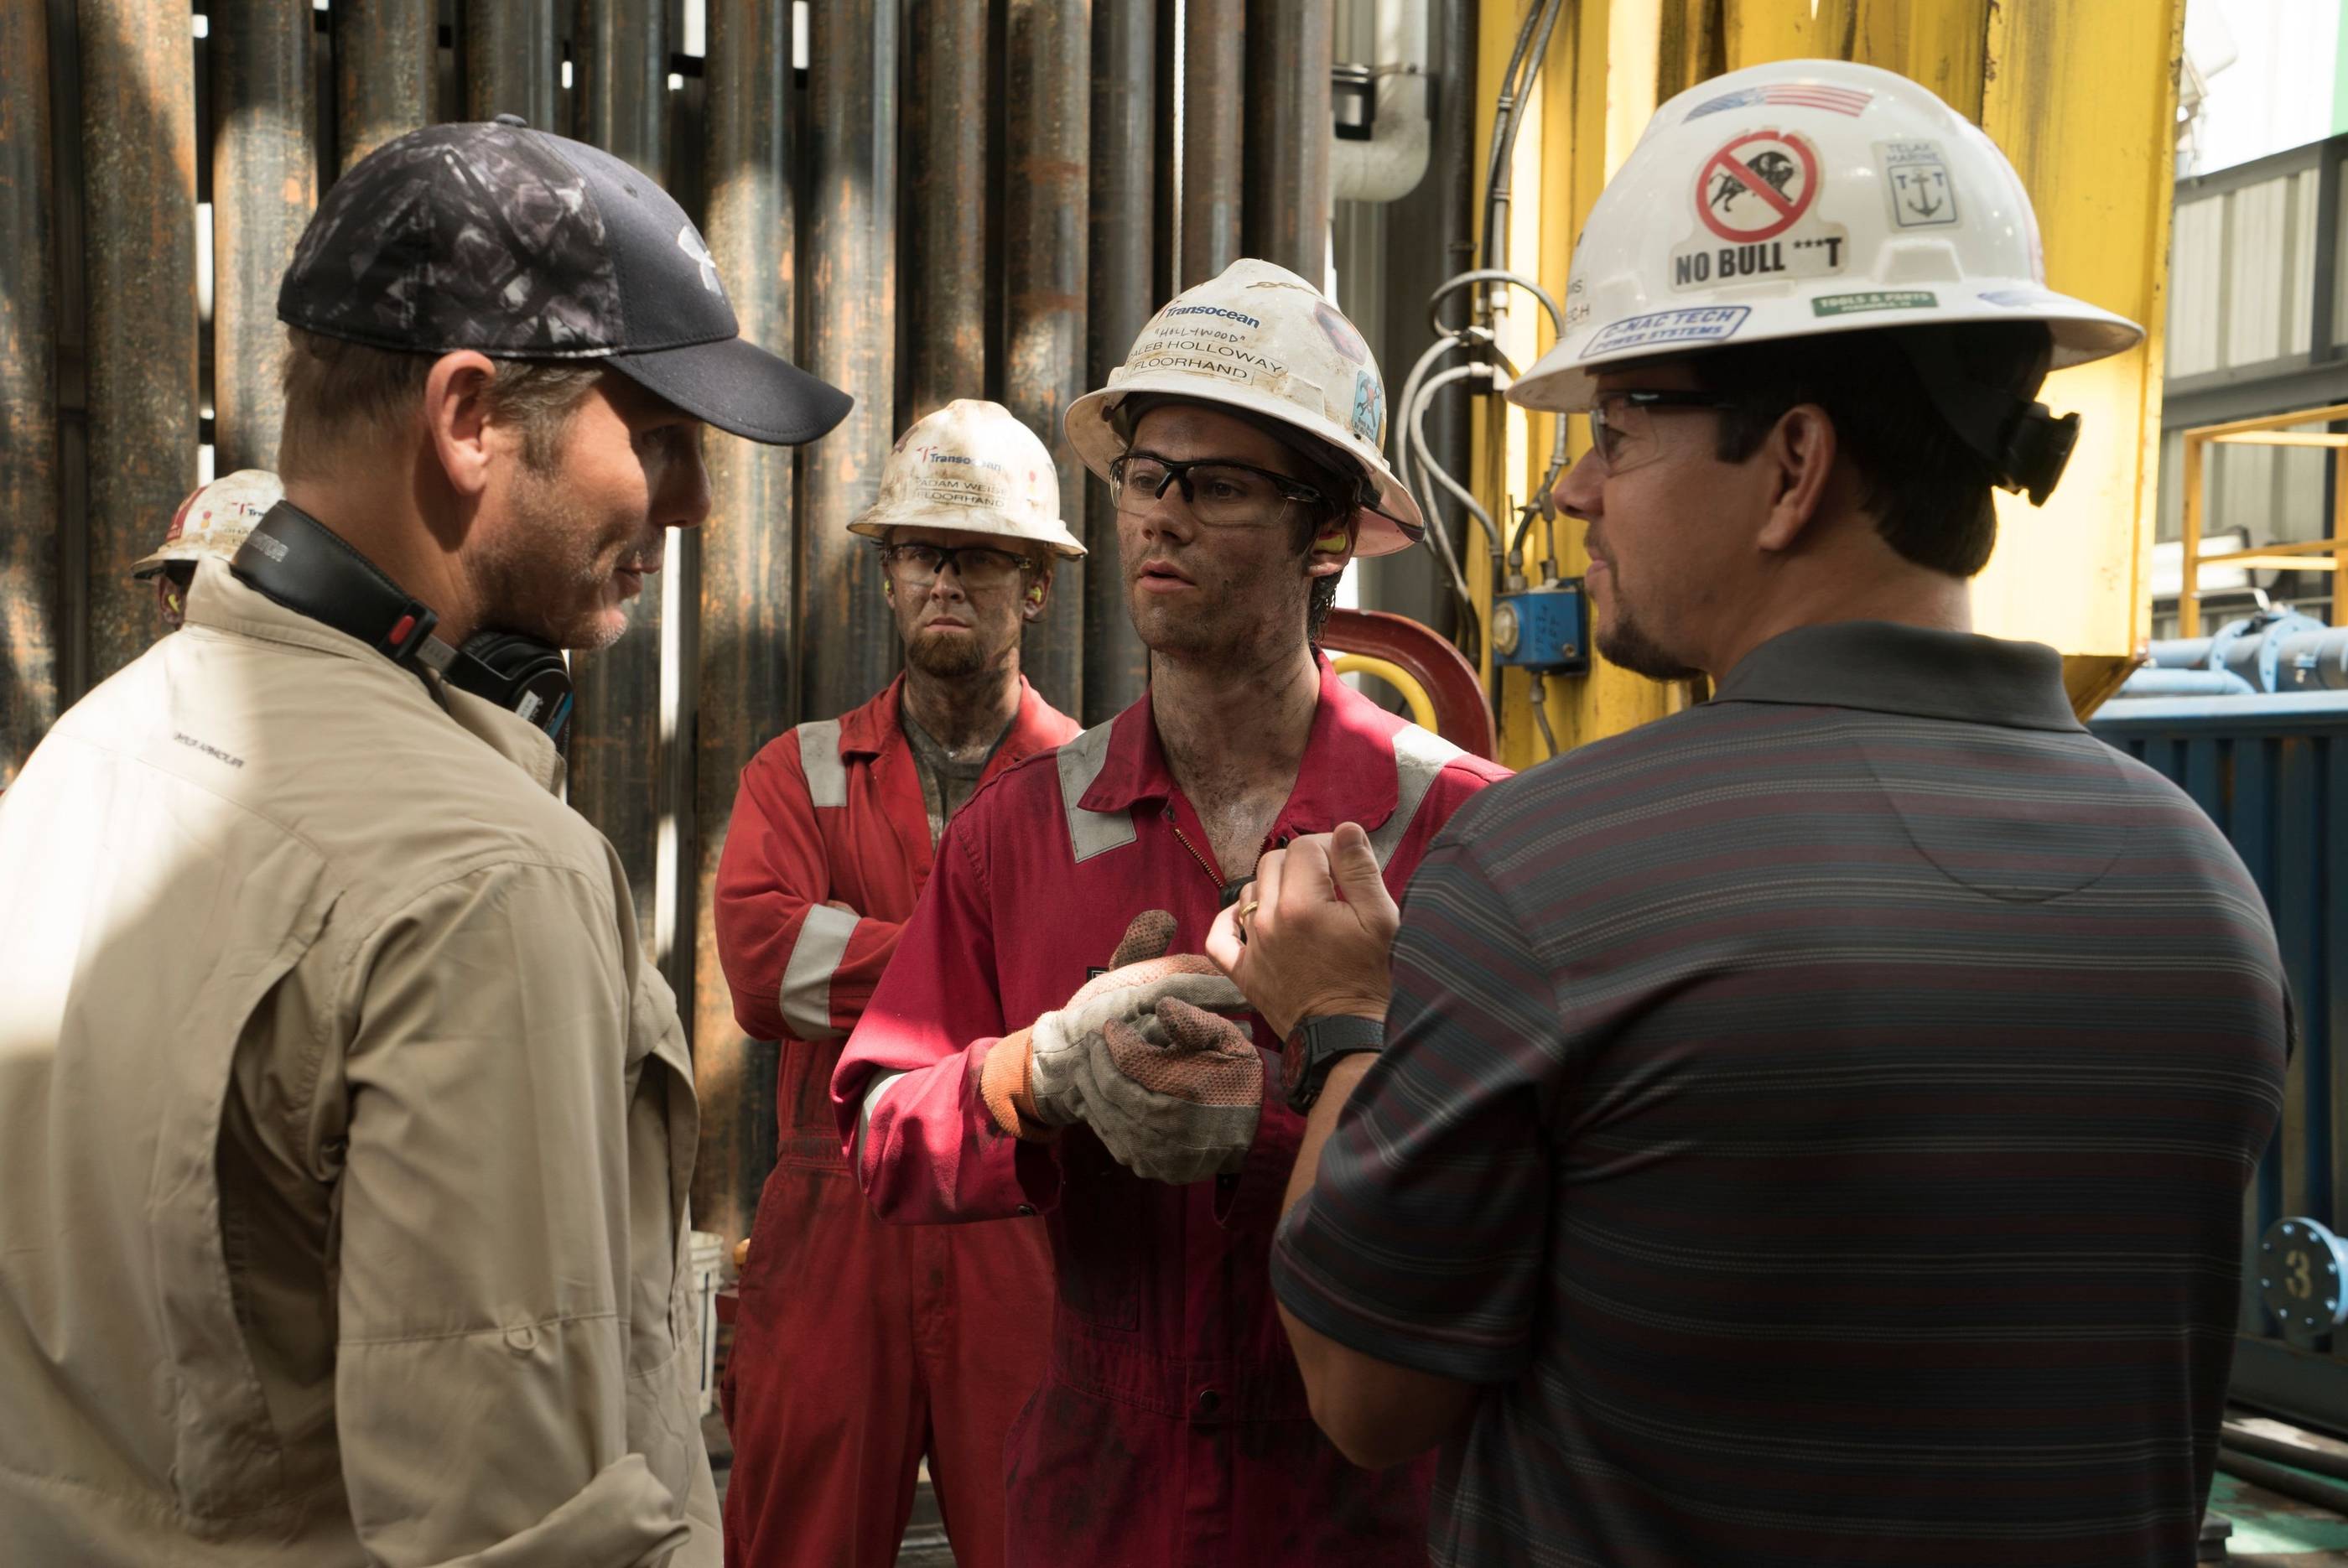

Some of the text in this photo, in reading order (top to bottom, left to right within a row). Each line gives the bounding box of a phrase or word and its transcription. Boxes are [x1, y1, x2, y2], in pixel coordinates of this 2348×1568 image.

[1676, 252, 1710, 286] NO
[1718, 242, 1785, 278] BULL
[1820, 294, 1867, 308] TOOLS
[1166, 306, 1260, 330] Transocean
[1673, 310, 1735, 325] TECH
[1648, 326, 1722, 340] SYSTEMS
[1167, 340, 1282, 373] HOLLOWAY
[1134, 358, 1248, 378] FLOORHAND
[917, 491, 1005, 507] FLOORHAND
[2286, 1249, 2313, 1299] 3
